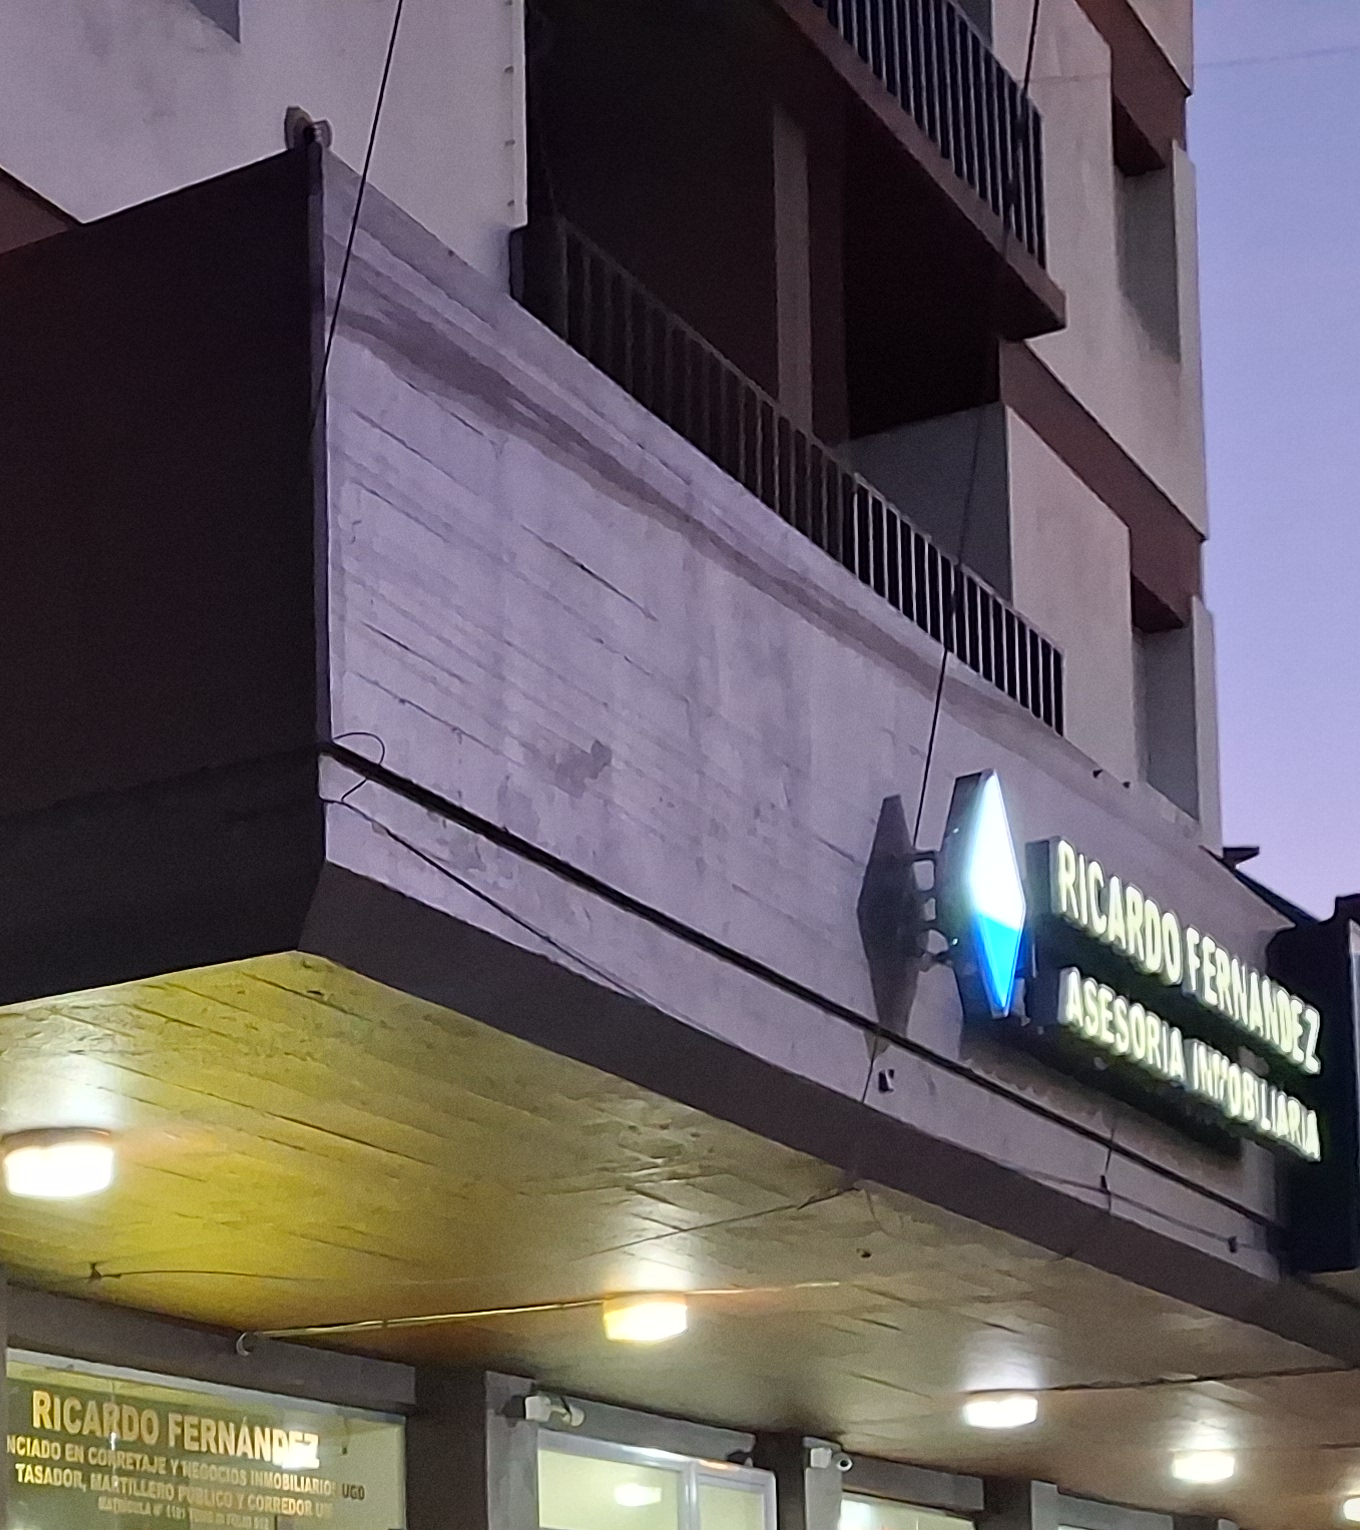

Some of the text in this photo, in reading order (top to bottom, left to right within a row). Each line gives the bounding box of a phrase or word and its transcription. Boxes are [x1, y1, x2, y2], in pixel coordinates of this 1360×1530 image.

[1055, 837, 1321, 1075] RICARDO FERNANDEZ
[1064, 968, 1322, 1161] ASESORIA INMOBILIARIA
[31, 1389, 161, 1446] RICARDO
